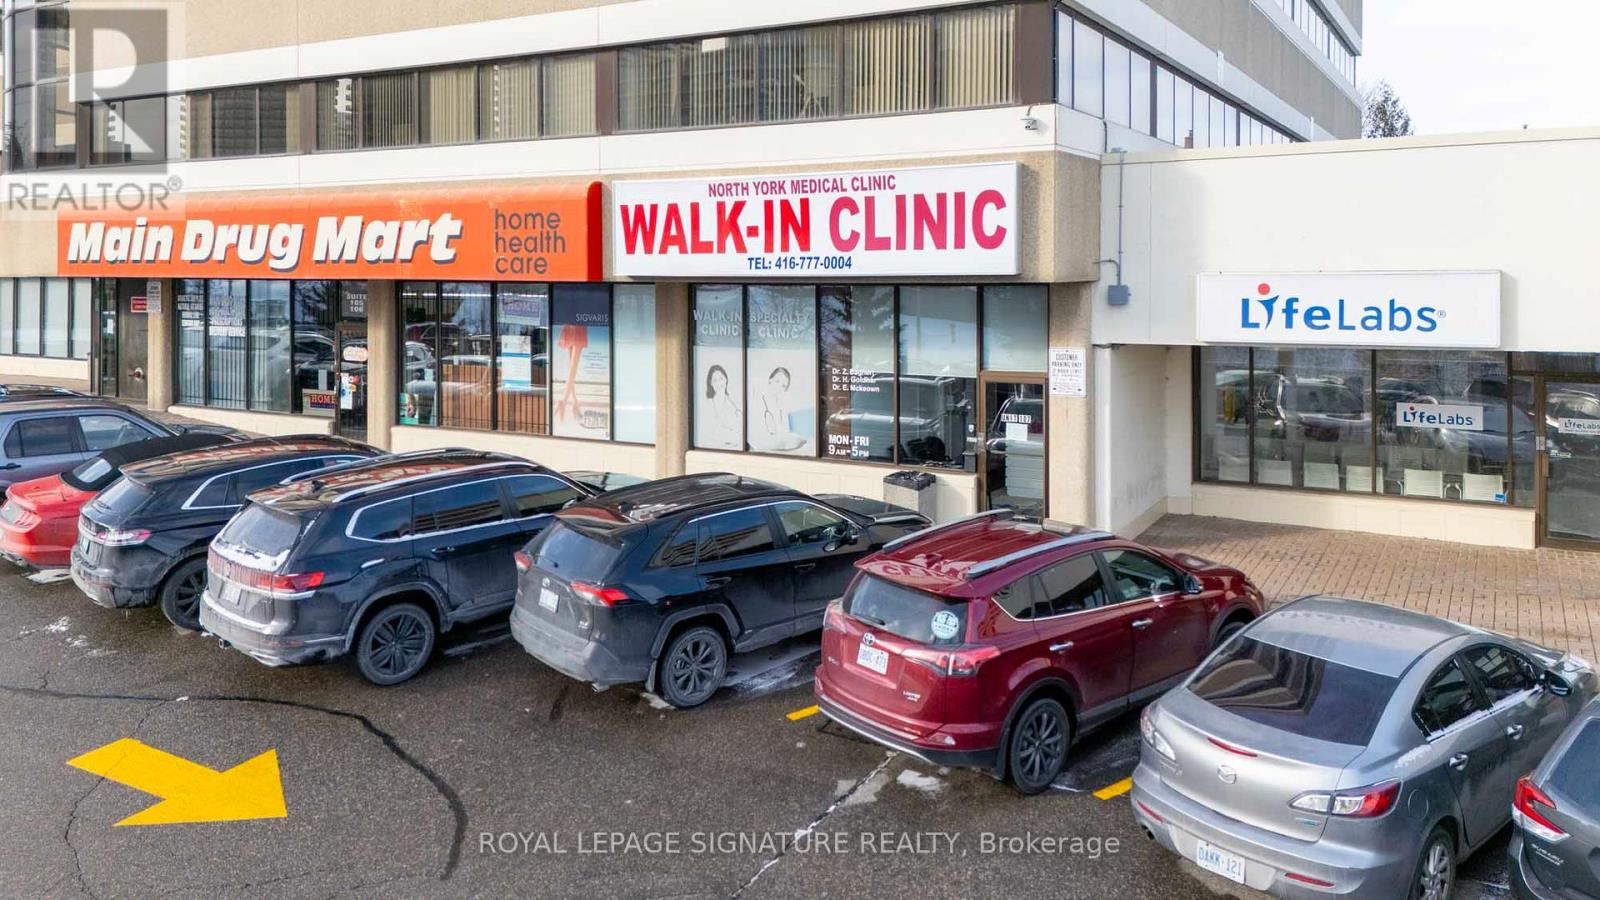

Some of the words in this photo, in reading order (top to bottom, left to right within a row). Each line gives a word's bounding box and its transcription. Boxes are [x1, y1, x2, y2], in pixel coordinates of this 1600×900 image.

[708, 181, 749, 198] NORTH
[752, 179, 786, 196] YORK
[790, 177, 848, 195] MEDICAL
[851, 174, 896, 192] CLINIC
[494, 208, 561, 229] home
[620, 197, 811, 255] WALK-IN
[829, 189, 1007, 252] CLINIC
[67, 216, 174, 264] Main
[180, 219, 304, 272] Drug
[312, 213, 463, 264] Mart
[494, 231, 566, 253] health
[495, 256, 548, 274] care
[747, 257, 772, 270] TEL:
[775, 255, 852, 270] 416-777-0004
[575, 313, 608, 322] SIGVARIS
[693, 309, 742, 322] WALK-IN
[750, 311, 810, 324] SPECIALTY
[702, 324, 739, 336] CLINIC
[759, 326, 799, 338] CLINIC
